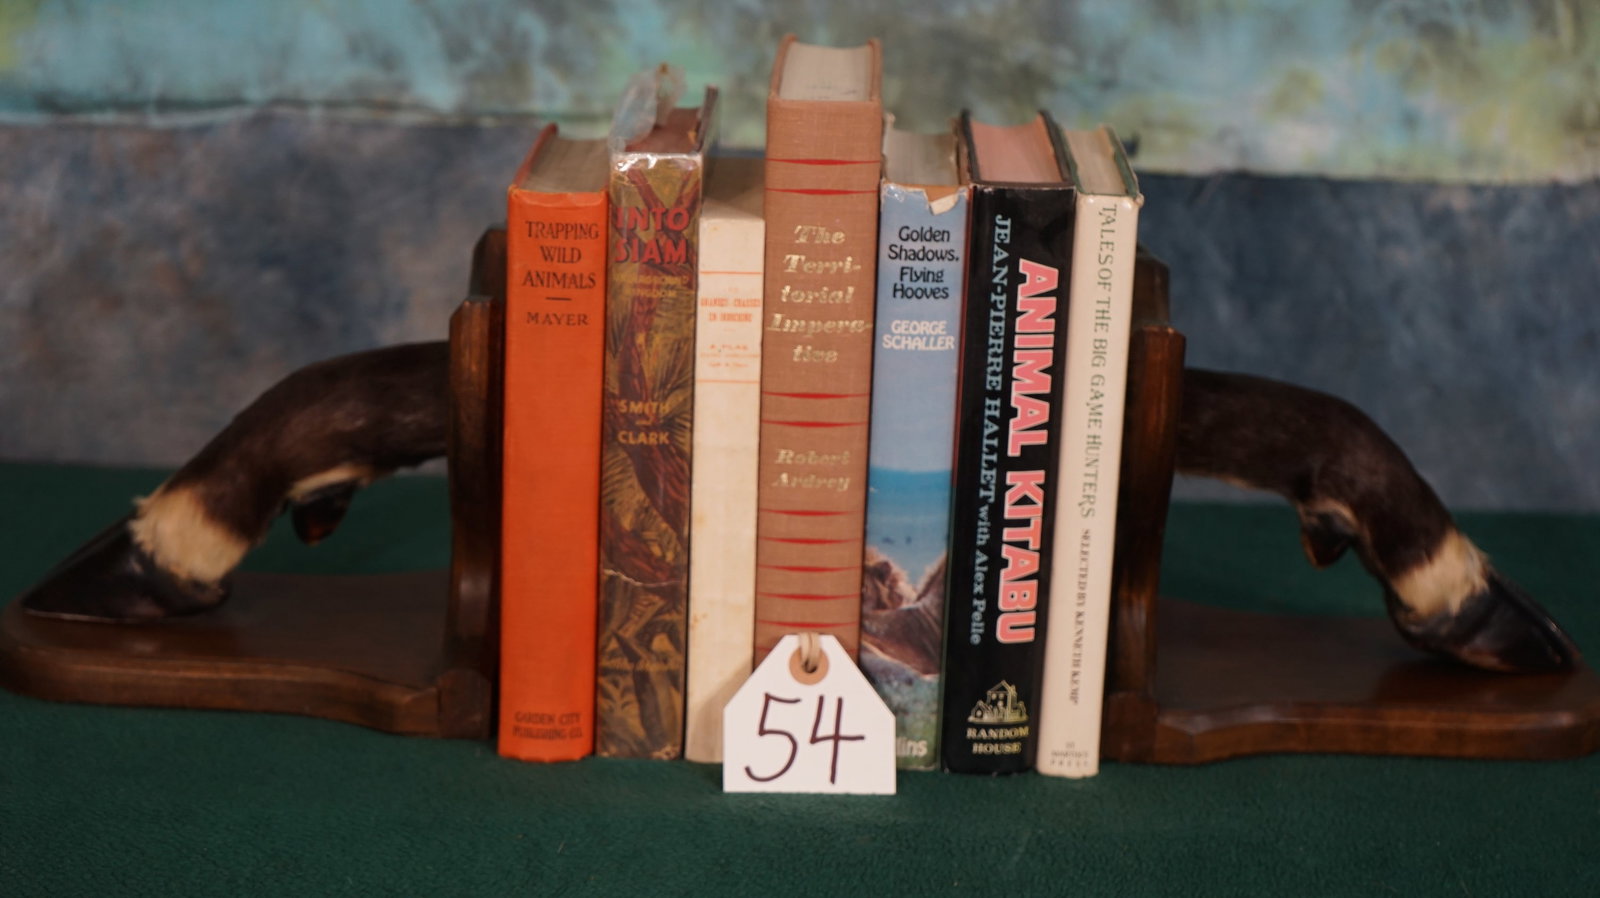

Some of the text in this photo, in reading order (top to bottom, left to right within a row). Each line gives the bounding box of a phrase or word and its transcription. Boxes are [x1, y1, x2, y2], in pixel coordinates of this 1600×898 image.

[615, 207, 690, 231] INTO
[525, 221, 599, 240] TRAPPING
[794, 225, 846, 244] The
[898, 225, 951, 243] Golden
[539, 246, 582, 264] WILD
[614, 239, 688, 264] SIAM
[783, 254, 861, 274] Terri-
[522, 271, 597, 289] ANIMALS
[899, 266, 944, 284] Flying
[781, 285, 855, 304] torial
[892, 284, 949, 300] Hooves
[527, 312, 589, 326] MAYER
[767, 313, 874, 338] Impera-
[891, 320, 947, 335] GEORGE
[882, 334, 956, 350] SCHALLER
[1077, 204, 1117, 519] TALES OF THE BIG GAME HUNTERS
[618, 400, 670, 415] SMITH
[618, 430, 670, 445] CLARK
[969, 214, 1012, 645] JEAN-PIERRE HALLET with Alex Pelle
[775, 449, 850, 466] Robert
[996, 257, 1059, 644] ANIMAL KITABU
[772, 473, 851, 492] Ardrey
[744, 691, 866, 785] 54
[966, 727, 1029, 740] RANDOM
[972, 742, 1021, 755] HOUSE
